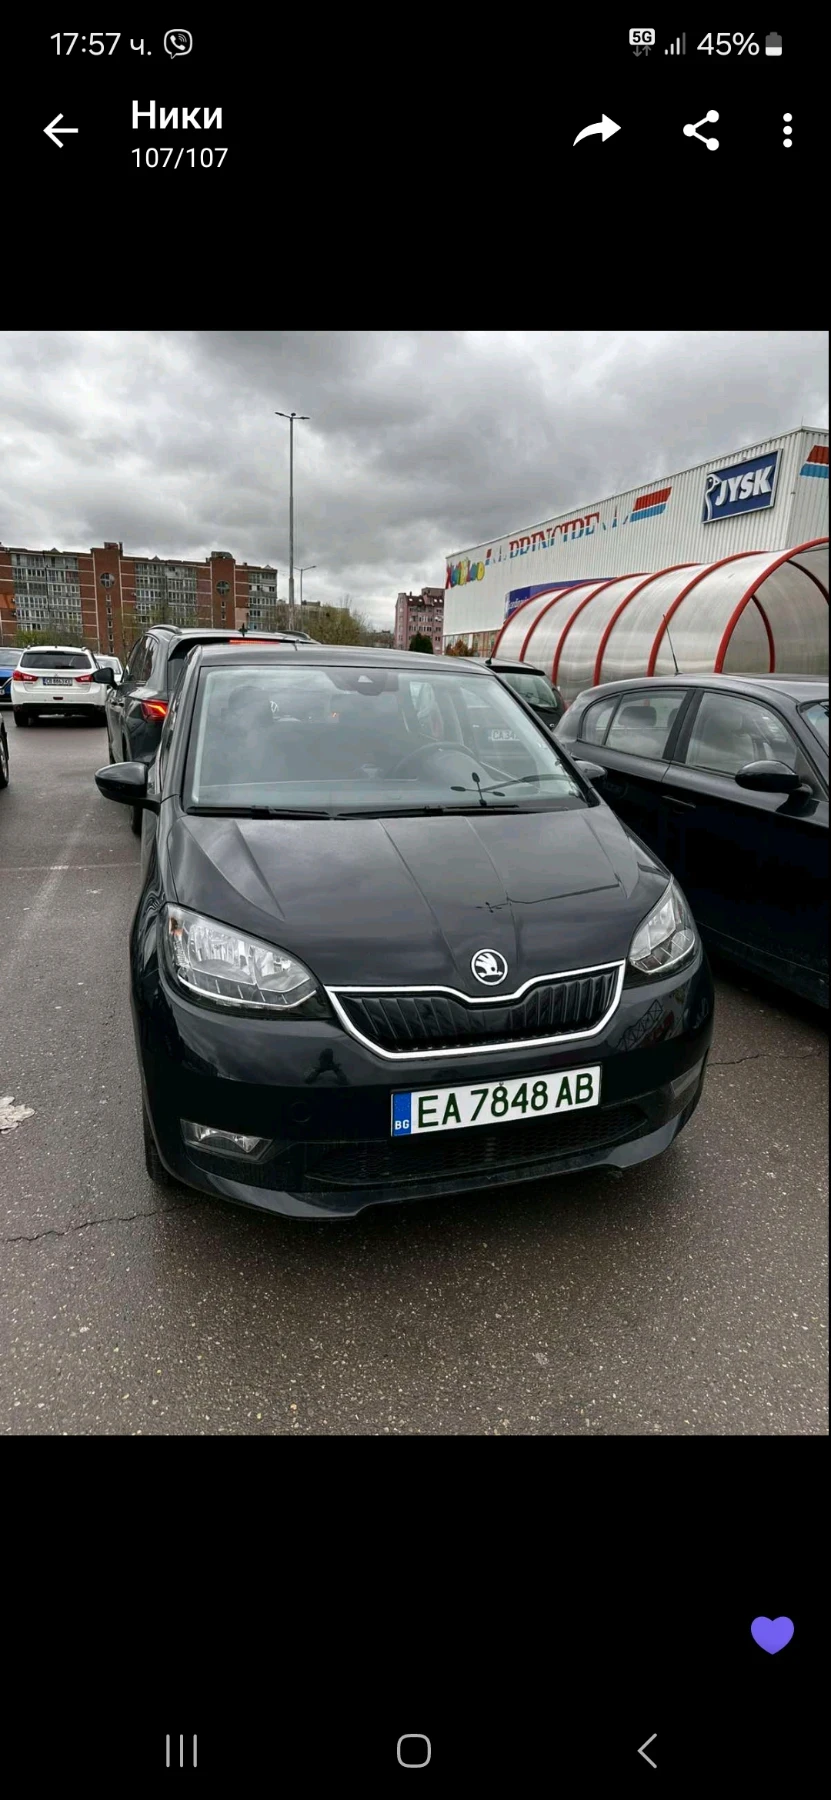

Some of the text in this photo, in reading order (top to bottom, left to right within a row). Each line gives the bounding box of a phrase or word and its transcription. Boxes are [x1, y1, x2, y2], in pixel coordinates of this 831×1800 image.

[714, 465, 774, 506] JYSK
[394, 1072, 594, 1130] BG EA 7848 AB
